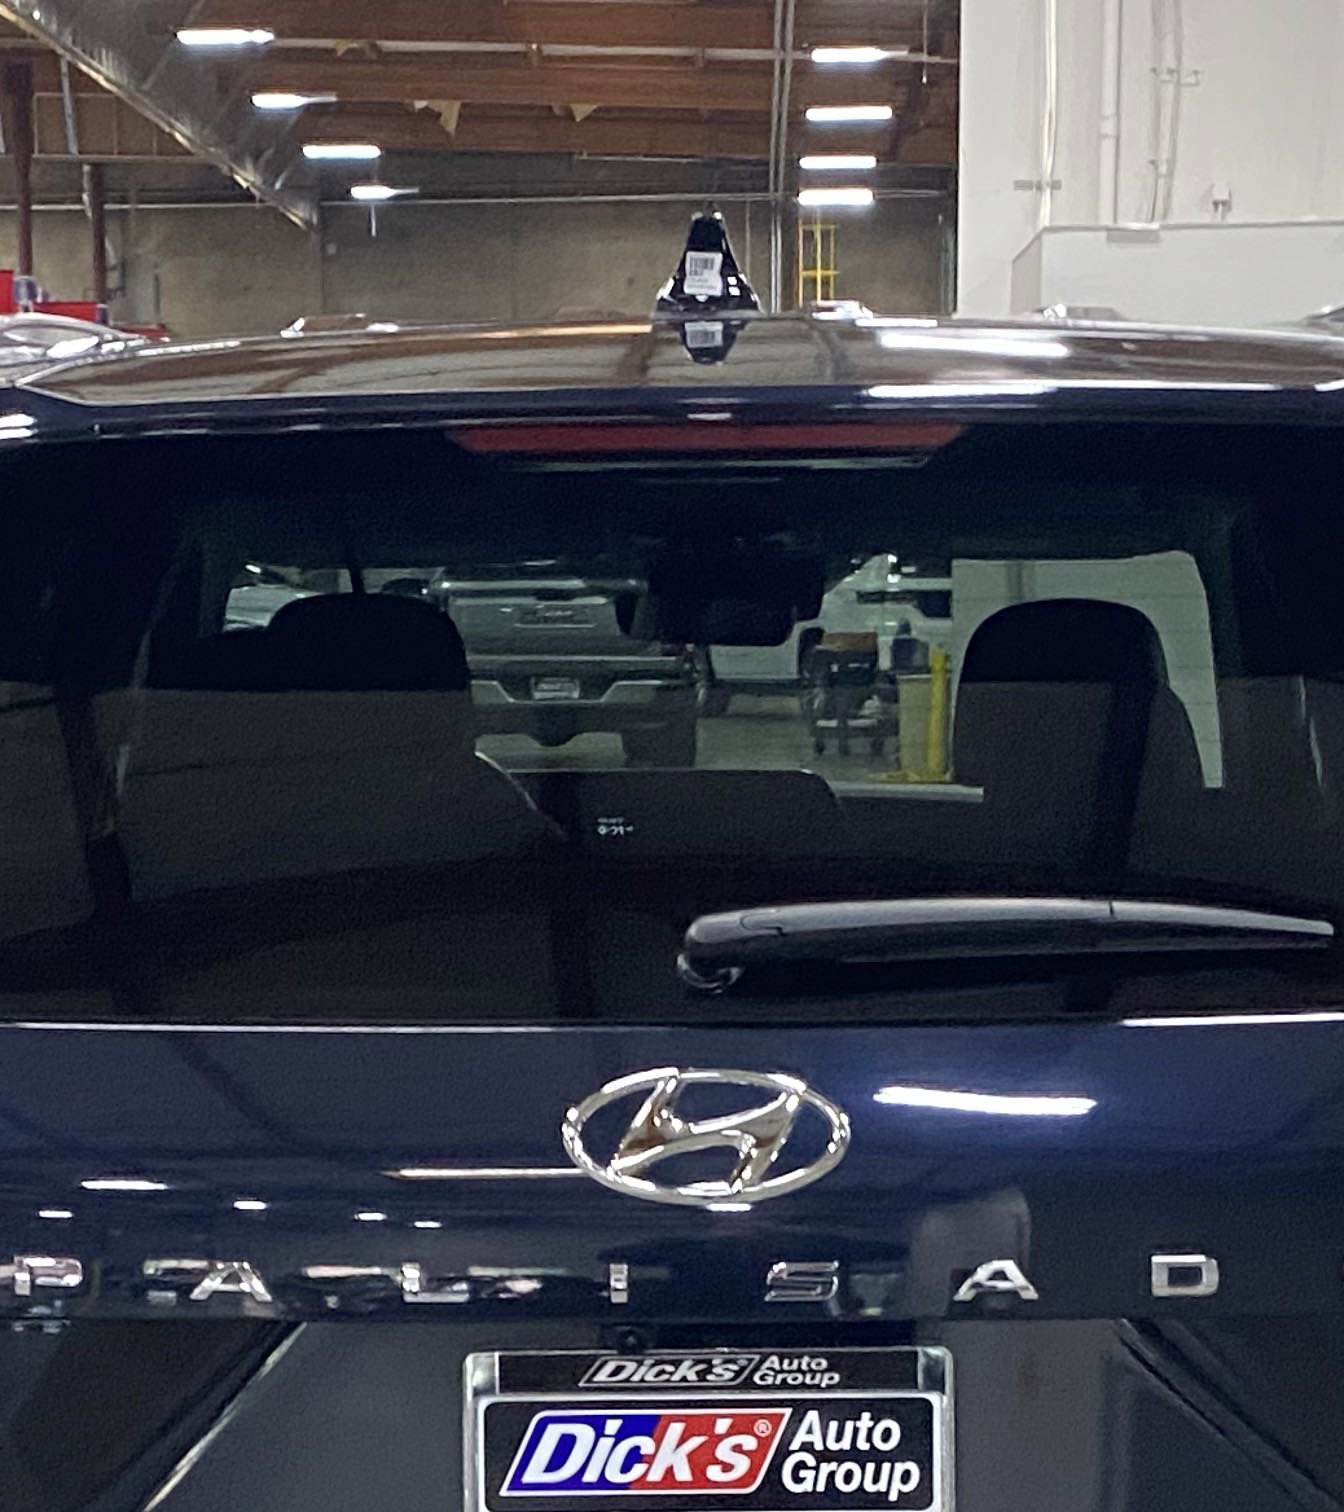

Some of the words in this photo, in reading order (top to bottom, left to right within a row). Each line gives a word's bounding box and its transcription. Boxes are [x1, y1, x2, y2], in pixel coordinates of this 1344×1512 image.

[592, 1357, 742, 1383] Dick's
[753, 1371, 840, 1388] Group
[758, 1355, 829, 1371] Auto
[788, 1411, 902, 1452] Auto
[520, 1416, 761, 1486] Dick's
[781, 1452, 921, 1502] Group
